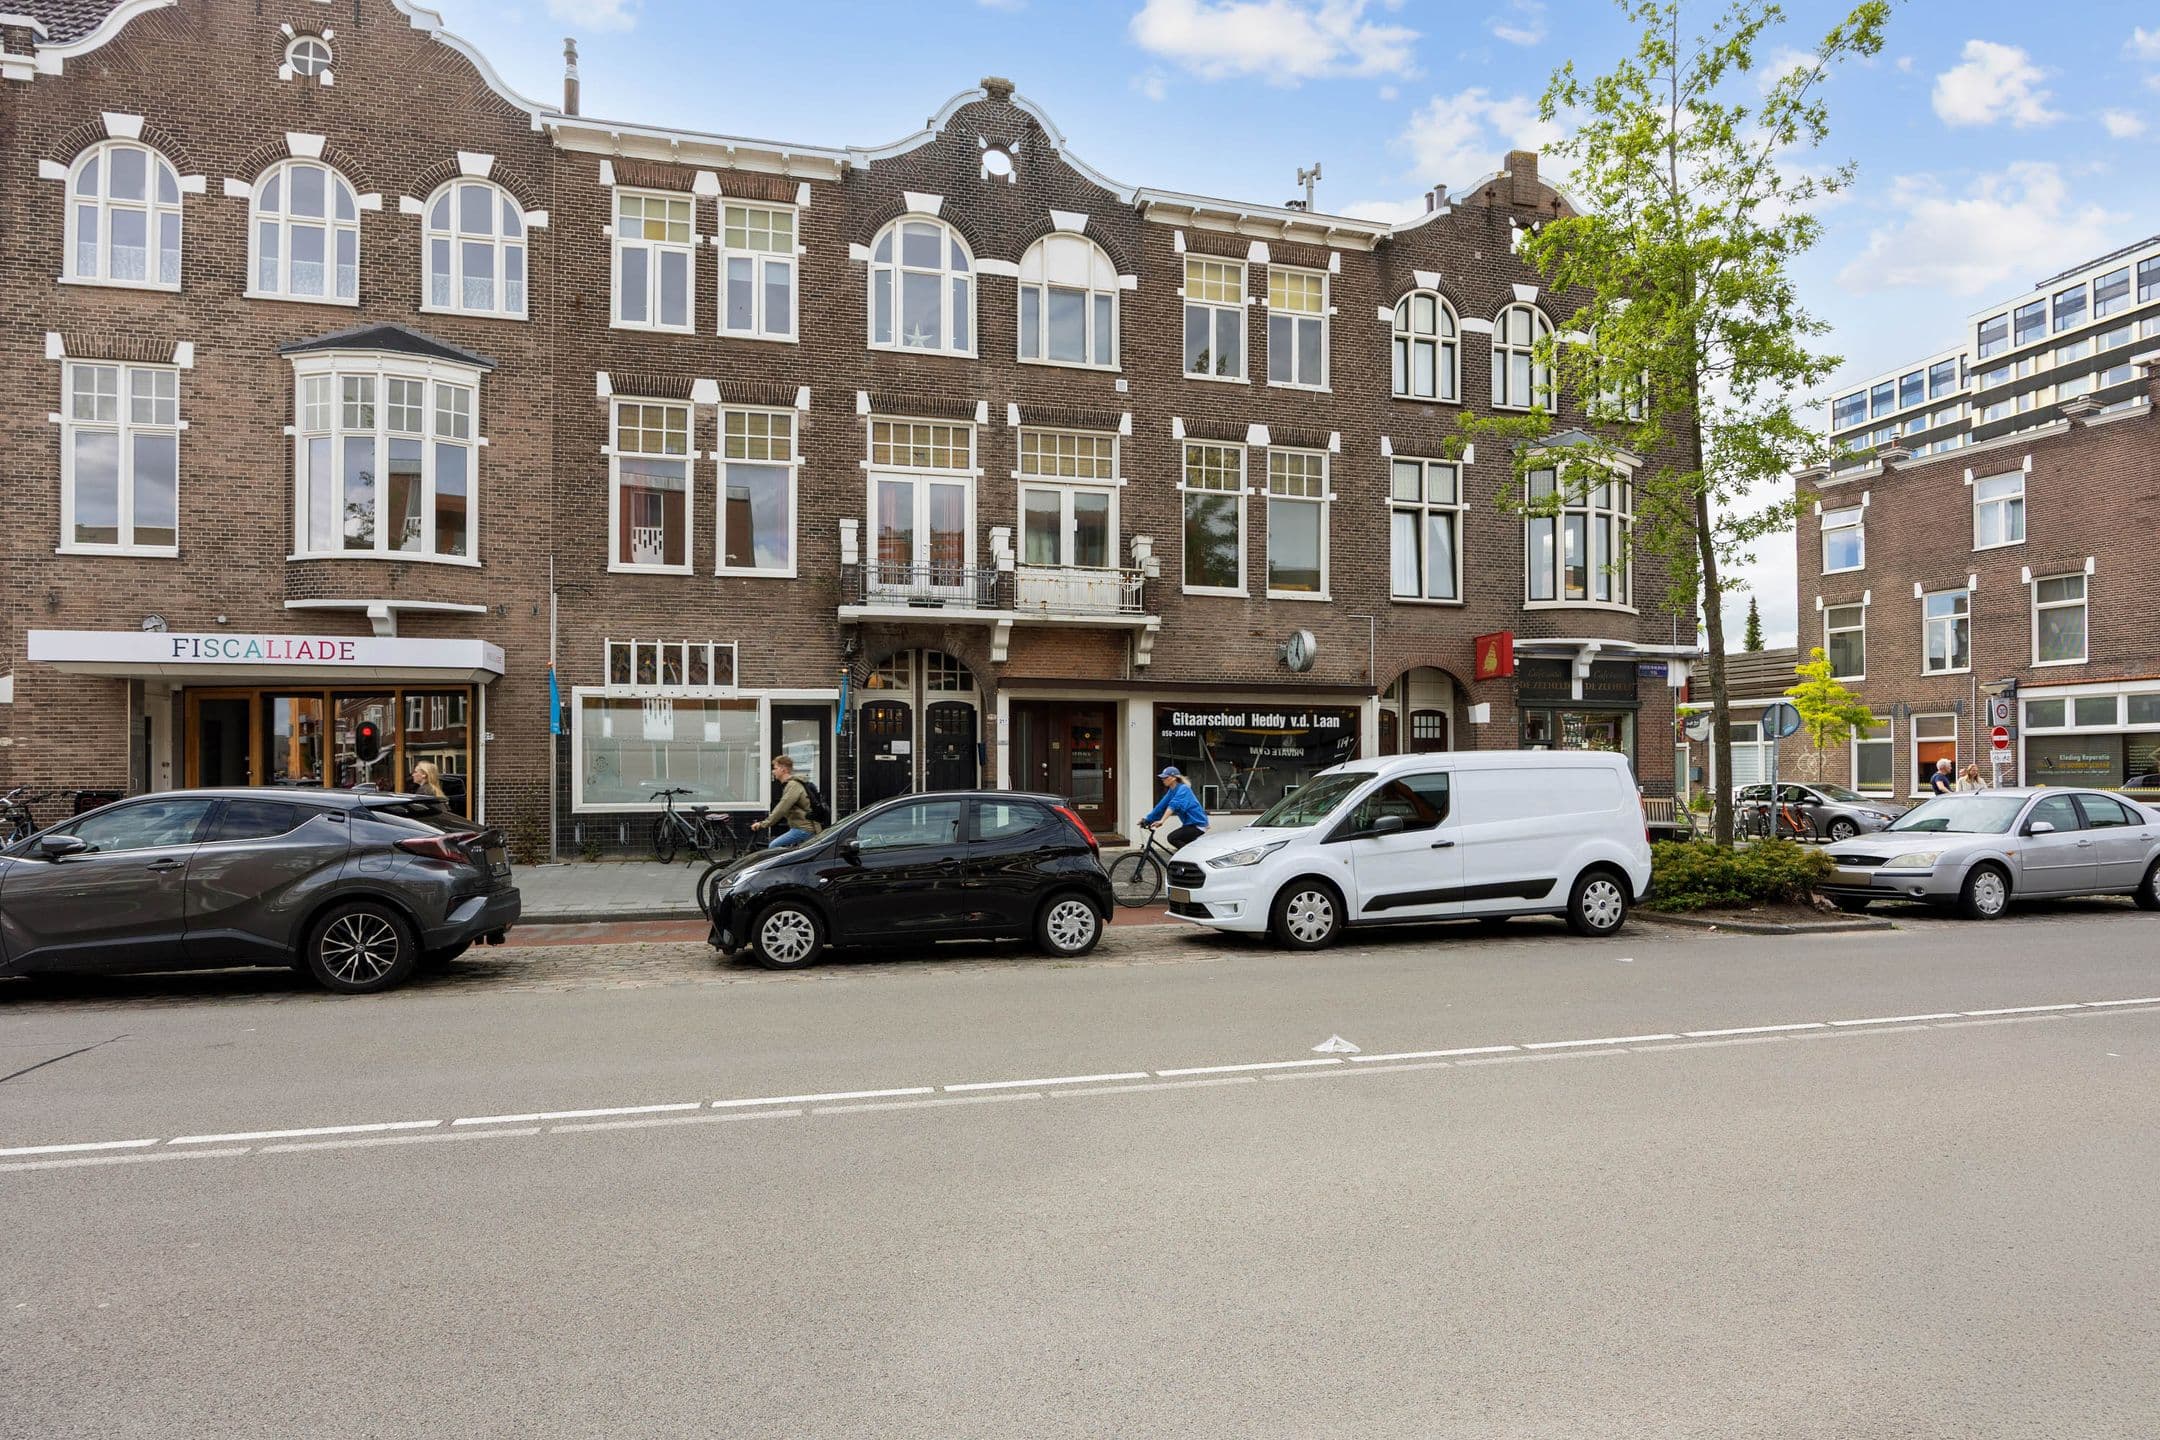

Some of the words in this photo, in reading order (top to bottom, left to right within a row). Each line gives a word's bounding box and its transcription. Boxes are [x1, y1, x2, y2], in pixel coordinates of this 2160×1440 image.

[172, 638, 355, 661] FISCALIADE
[1172, 712, 1246, 727] Gitaarschool
[1251, 713, 1286, 729] Heddy
[1290, 714, 1310, 728] v.d.
[1313, 714, 1340, 728] Laan
